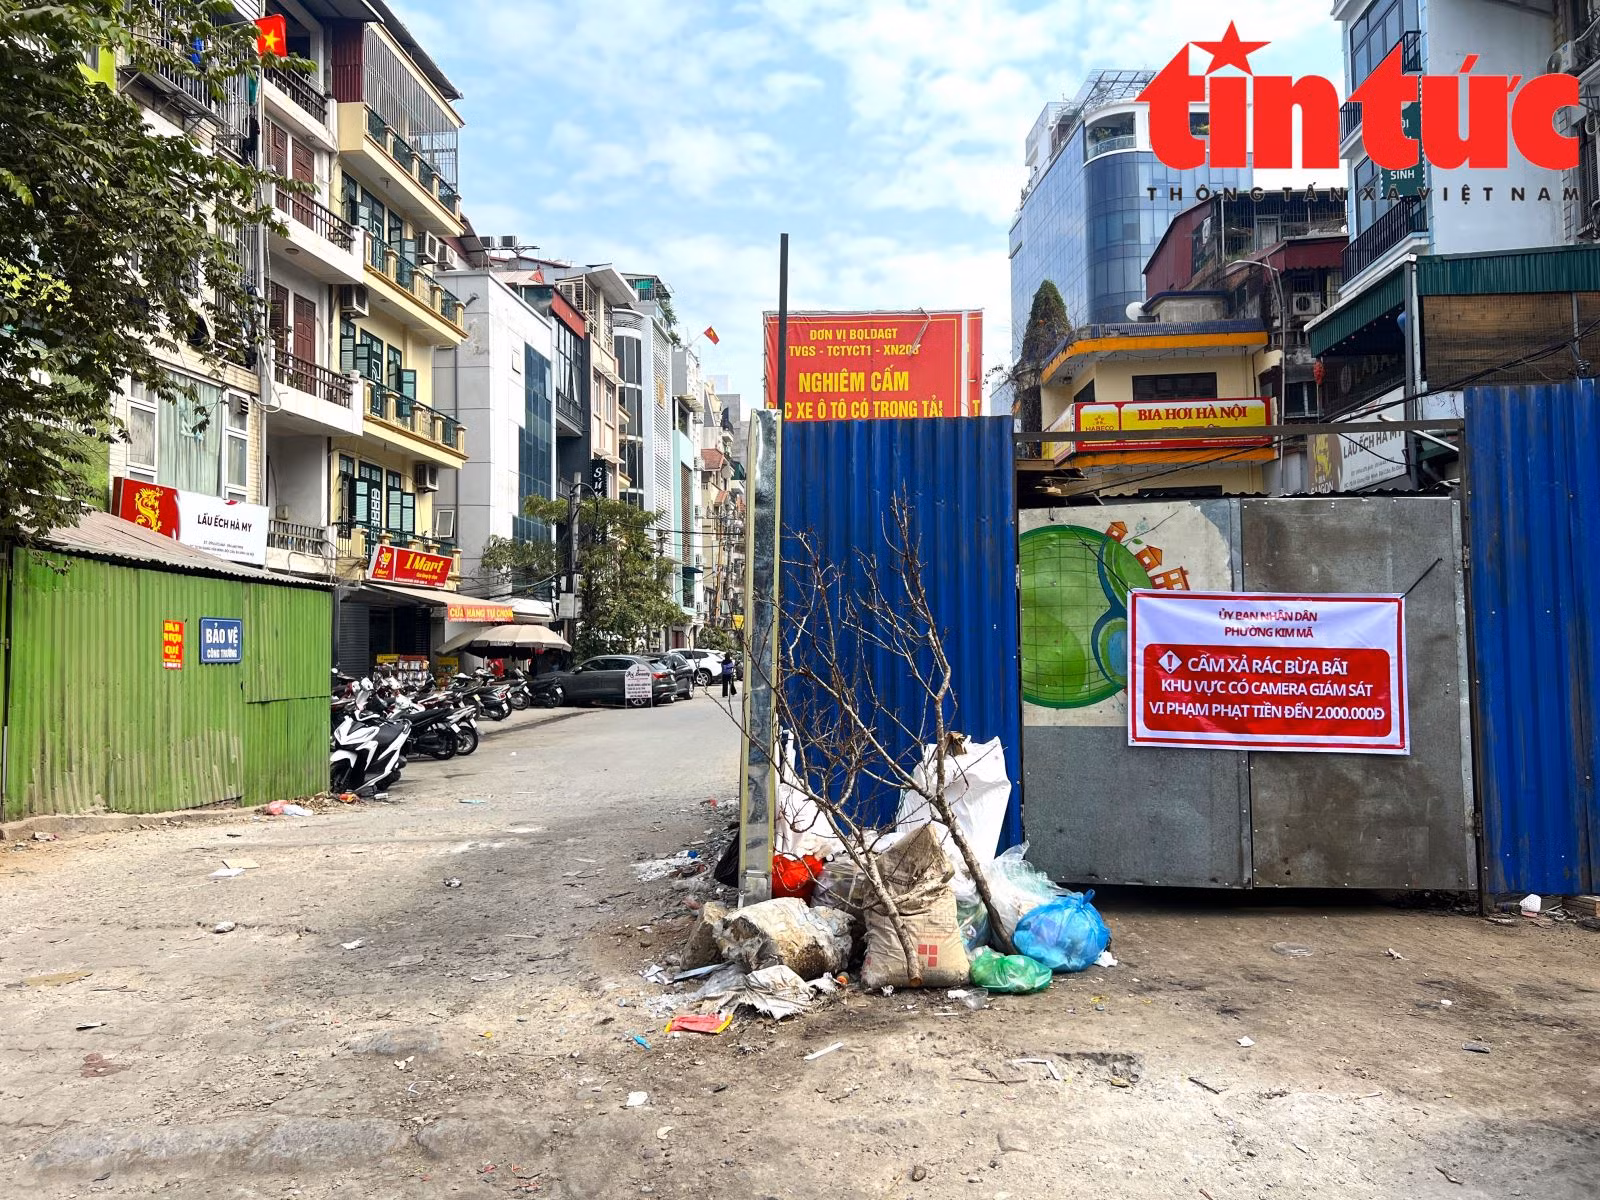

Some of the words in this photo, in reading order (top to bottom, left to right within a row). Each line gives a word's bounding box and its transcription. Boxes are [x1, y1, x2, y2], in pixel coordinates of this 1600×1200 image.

[1390, 169, 1415, 180] SINH
[836, 329, 846, 342] VỊ
[849, 327, 898, 341] BQLDAGT
[788, 345, 816, 357] TVGS
[826, 344, 872, 357] TCTYCT1
[798, 367, 866, 393] NGHIÊM
[870, 364, 909, 392] CẤM
[796, 401, 814, 419] XE
[817, 398, 827, 419] Ô
[830, 398, 847, 419] TÔ
[850, 397, 869, 419] CÓ
[1137, 409, 1164, 421] BIA
[1164, 406, 1193, 421] HƠI
[1195, 404, 1218, 419] HÀ
[1220, 403, 1249, 421] NỘI
[213, 514, 229, 529] ẾCH
[229, 518, 240, 531] HÀ
[1218, 607, 1235, 620] ỦY
[1235, 611, 1258, 621] BAN
[1260, 609, 1294, 621] NHÂN
[1294, 609, 1318, 621] DÂN
[205, 622, 226, 644] BẢO
[227, 626, 239, 647] VỆ
[1224, 625, 1273, 637] PHƯỜNG
[1274, 627, 1295, 638] KIM
[1296, 626, 1314, 638] MÃ
[1187, 653, 1225, 673] CẤM
[1227, 654, 1250, 673] XẢ
[1252, 656, 1283, 674] RÁC
[1284, 656, 1320, 675] BỪA
[1322, 657, 1349, 675] BÃI
[1161, 678, 1192, 692] KHU
[1193, 680, 1227, 697] VỰC
[1228, 678, 1249, 694] CÓ
[1251, 681, 1308, 696] CAMERA
[1309, 680, 1347, 697] GIÁM
[1348, 680, 1374, 697] SÁT
[1148, 701, 1165, 715] VI
[1166, 702, 1209, 719] PHẠM
[1211, 704, 1250, 721] PHẠT
[1251, 701, 1282, 718] TIỀN
[1283, 701, 1313, 719] ĐẾN
[1314, 706, 1386, 720] 2.000.000Đ
